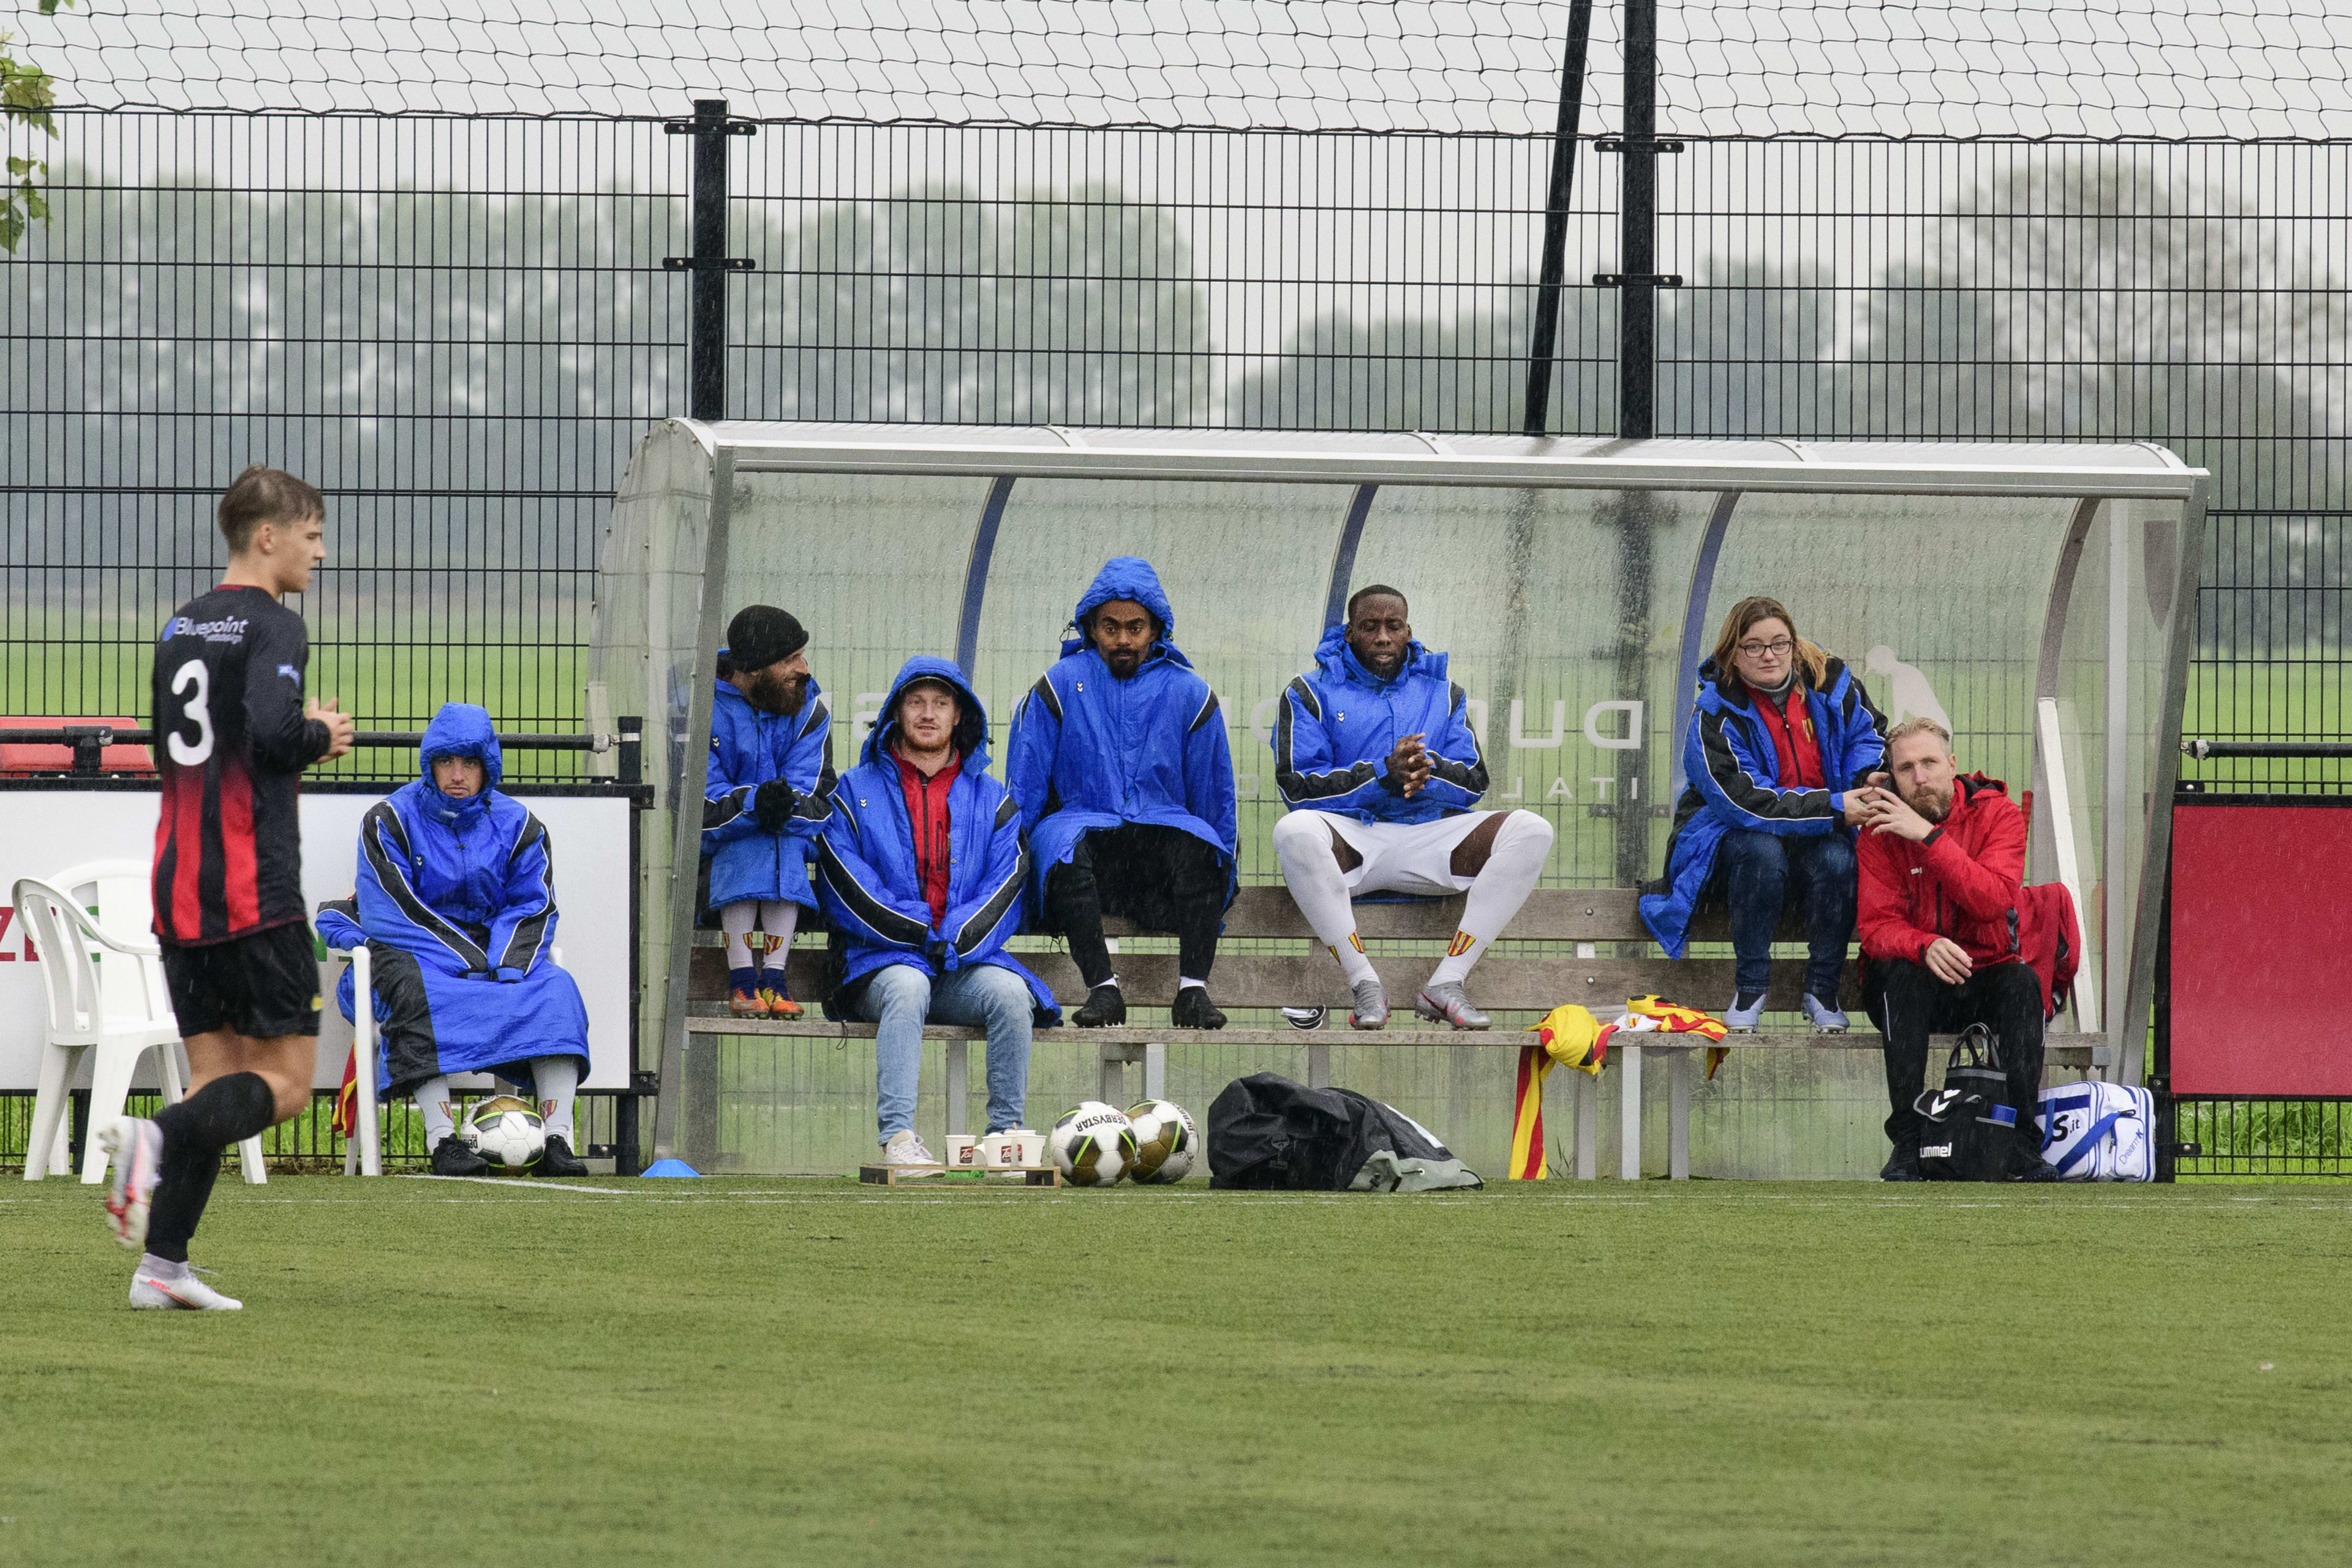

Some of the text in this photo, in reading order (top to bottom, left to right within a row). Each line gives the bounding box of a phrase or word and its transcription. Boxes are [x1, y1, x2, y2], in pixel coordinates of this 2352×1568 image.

[174, 616, 249, 638] Bluepoint
[167, 658, 214, 766] 3
[1075, 1111, 1127, 1133] DERBYSTAR
[1919, 1142, 1952, 1158] ummel
[2119, 1128, 2144, 1165] DreamK
